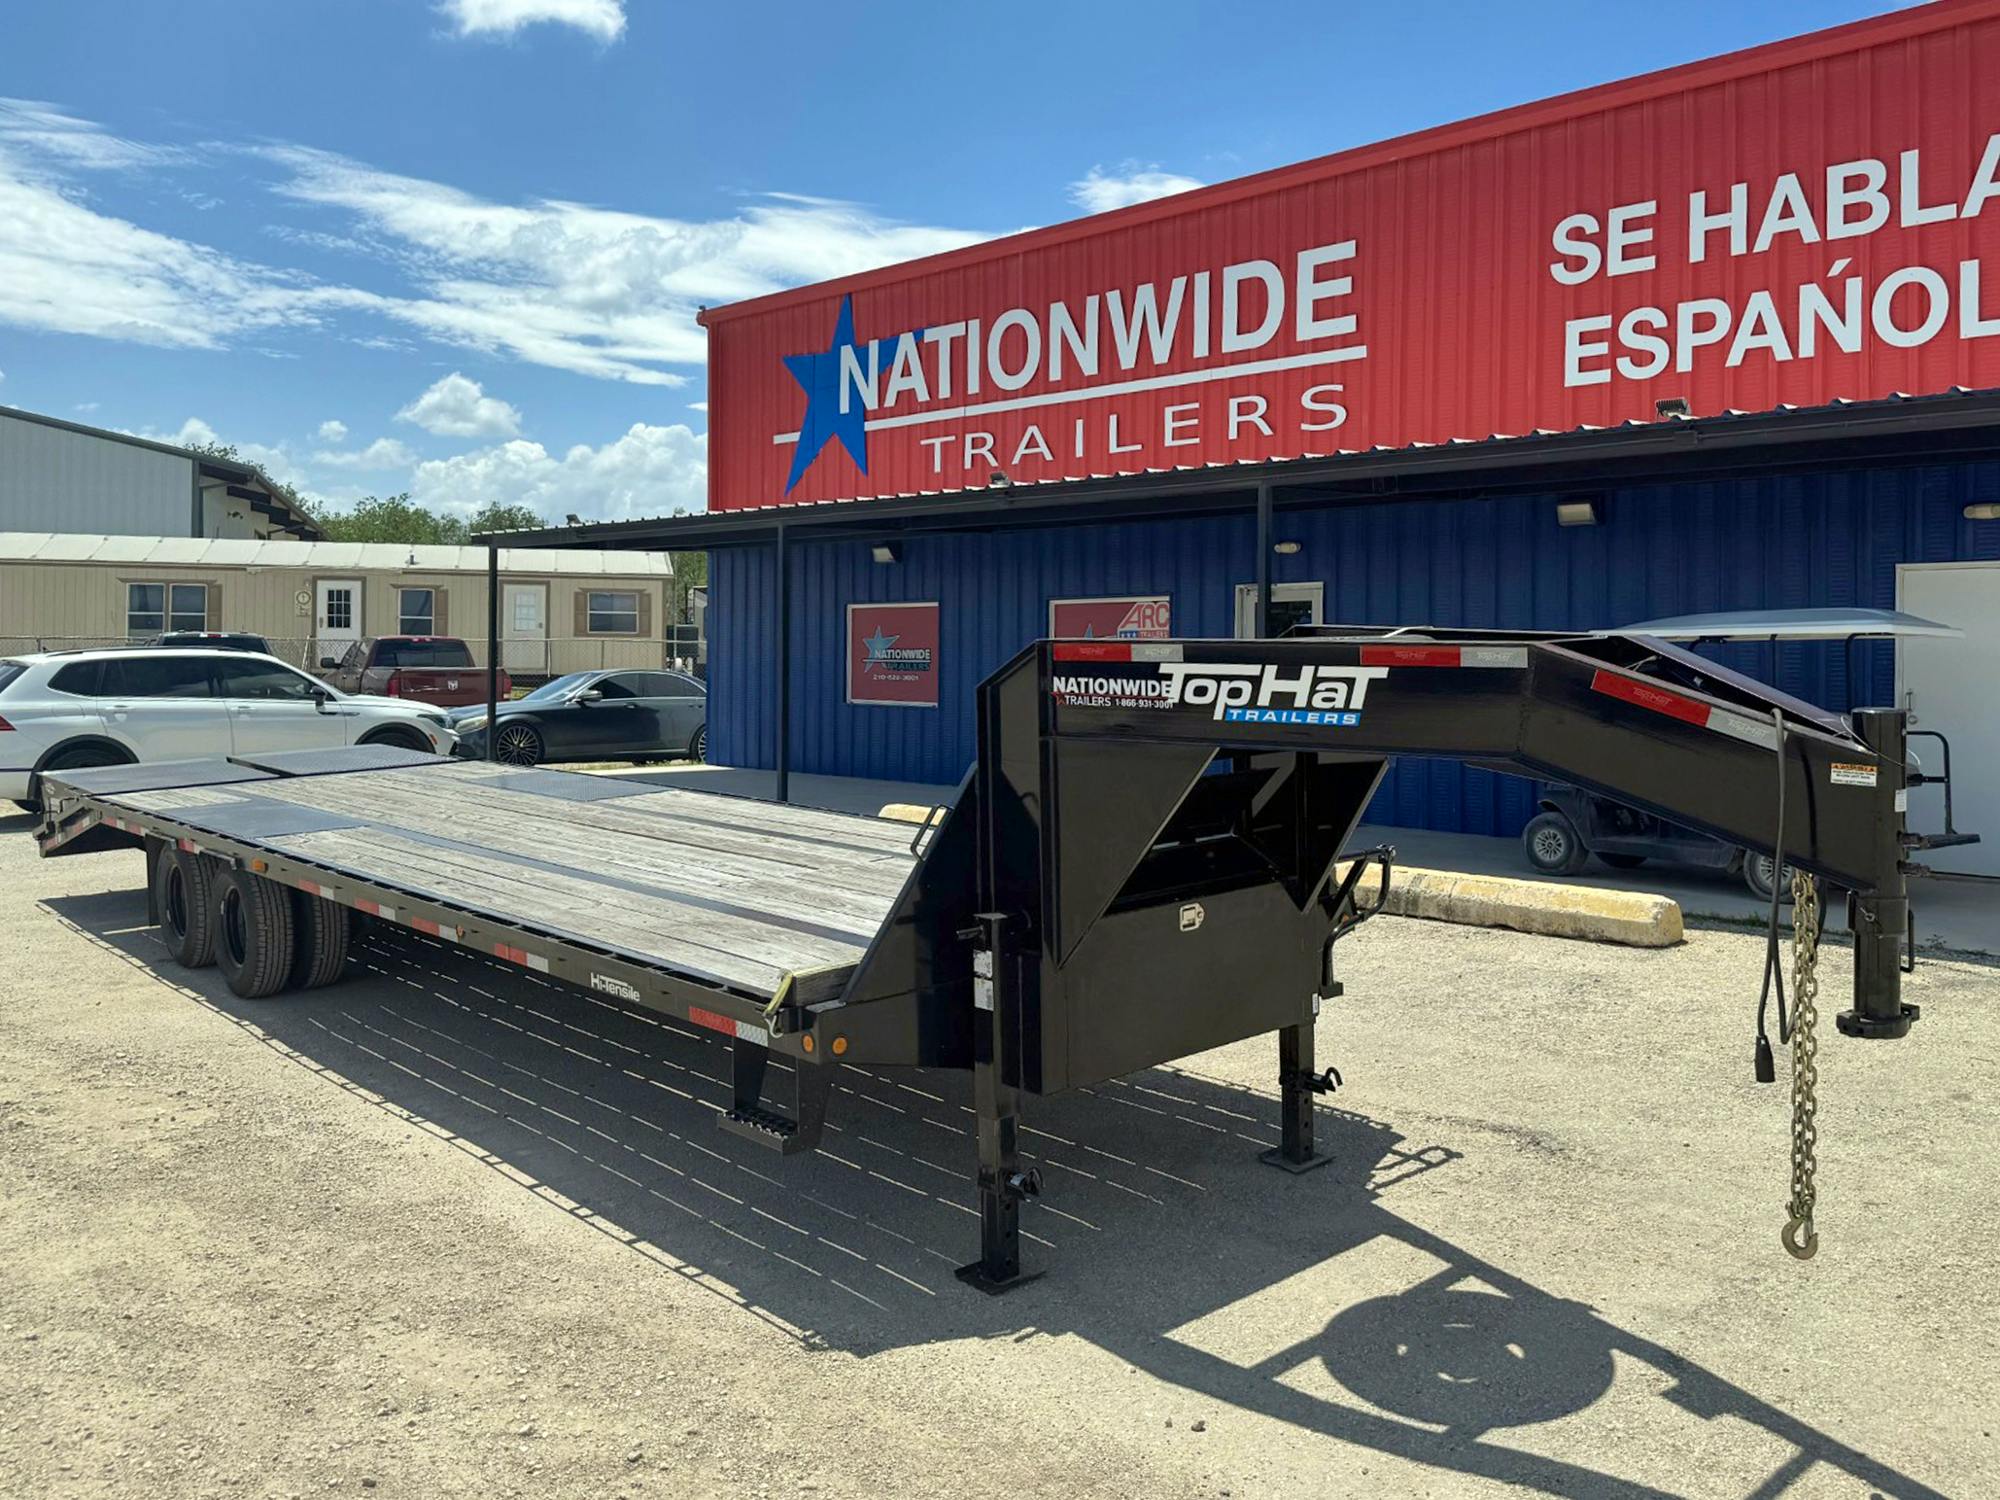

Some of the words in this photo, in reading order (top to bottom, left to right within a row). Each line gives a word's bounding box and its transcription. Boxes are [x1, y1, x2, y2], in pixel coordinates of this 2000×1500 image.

[1549, 200, 1657, 285] SE
[839, 239, 1358, 415] NATIONWIDE
[919, 384, 1349, 474] TRAILERS
[1119, 603, 1169, 629] ARC
[875, 648, 931, 660] NATIONWIDE
[1052, 676, 1172, 697] NATIONWIDE
[1064, 695, 1112, 707] TRAILERS
[1229, 709, 1358, 725] TRAILERS
[590, 972, 641, 1002] Hi-Tensile
